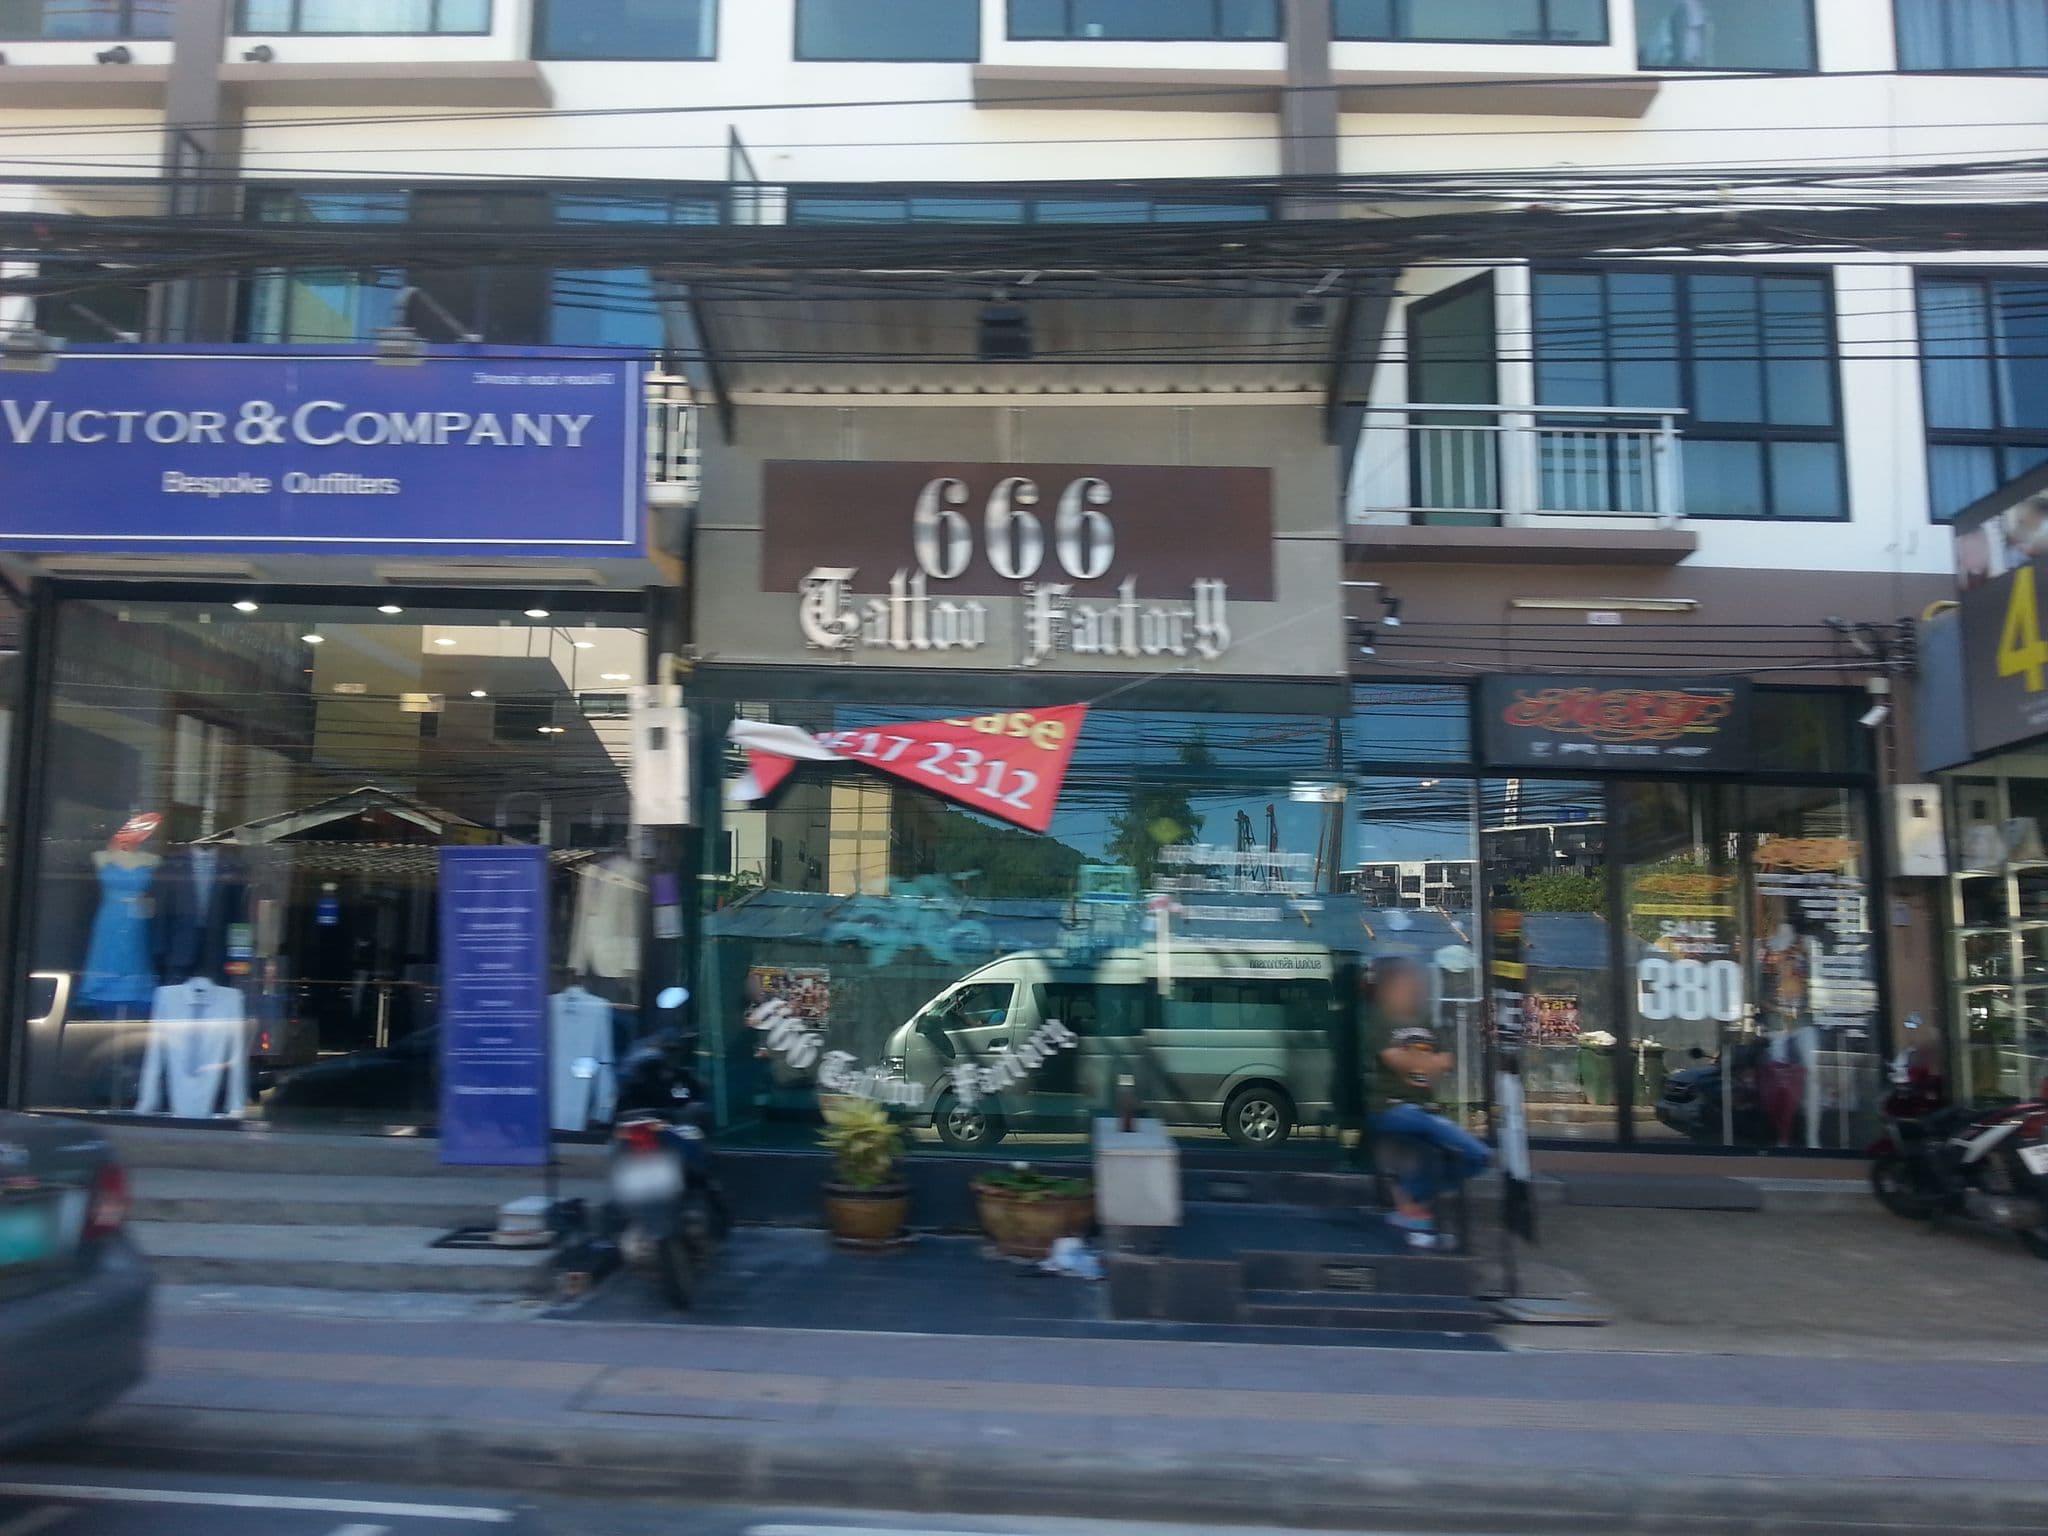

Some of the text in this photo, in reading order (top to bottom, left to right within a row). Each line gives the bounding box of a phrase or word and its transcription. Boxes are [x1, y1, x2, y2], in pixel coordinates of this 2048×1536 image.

[161, 471, 400, 497] Bespoke Outfitters
[912, 476, 1116, 579] 666
[800, 566, 988, 662] Tattoo
[916, 741, 1040, 810] 2312
[1637, 958, 1743, 1021] 380
